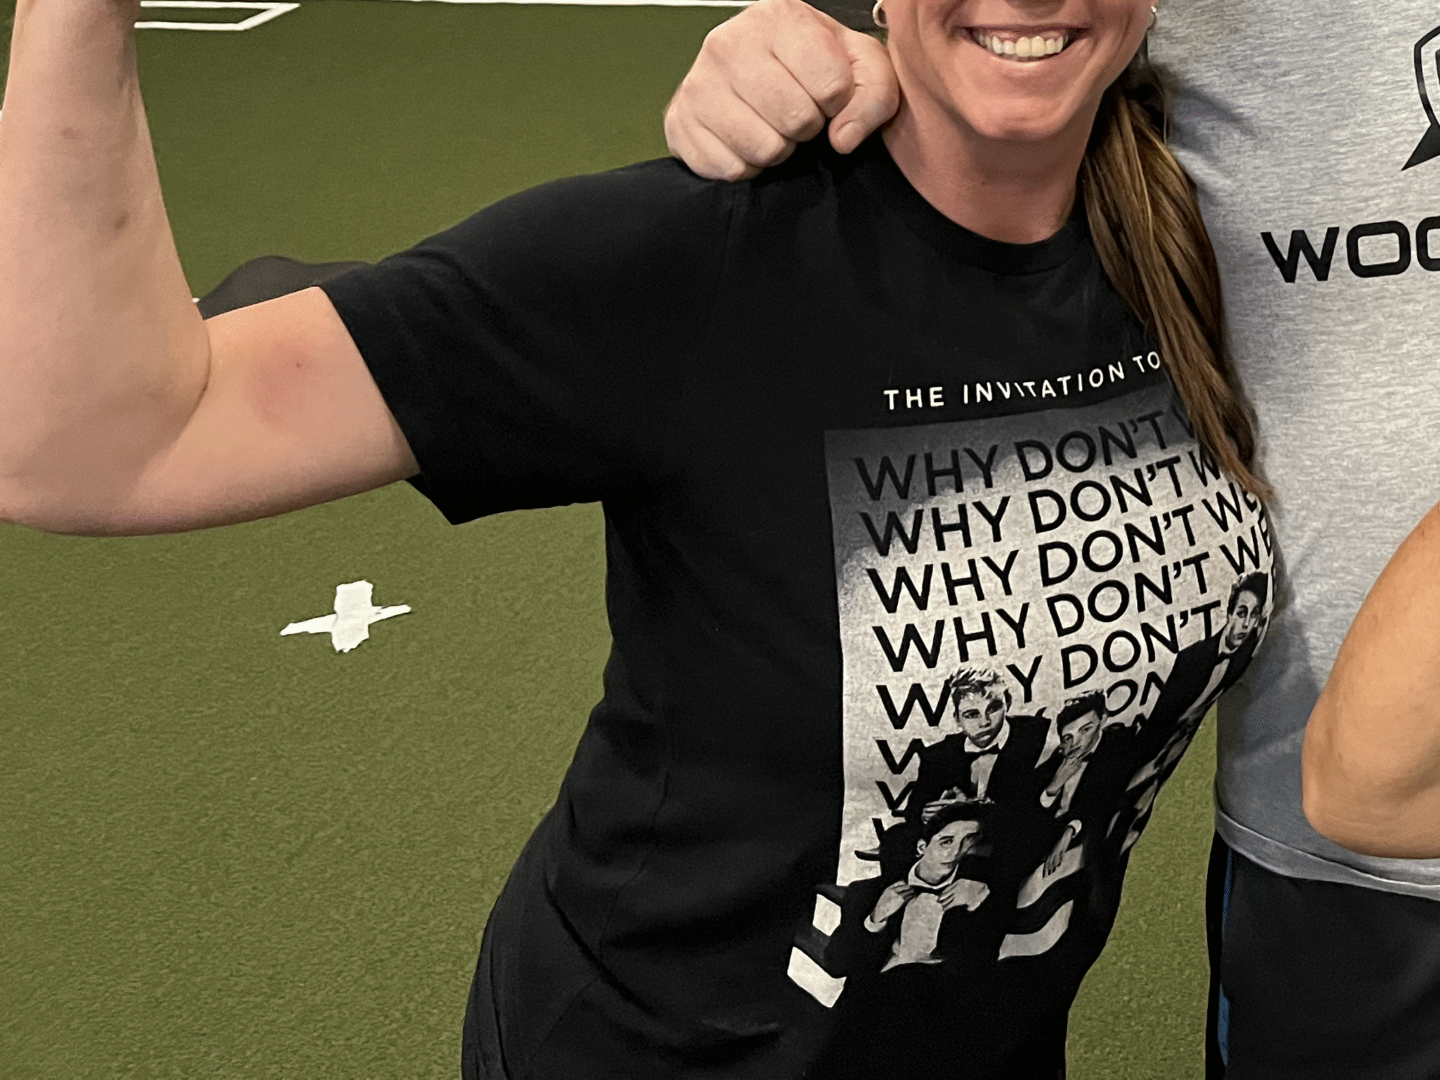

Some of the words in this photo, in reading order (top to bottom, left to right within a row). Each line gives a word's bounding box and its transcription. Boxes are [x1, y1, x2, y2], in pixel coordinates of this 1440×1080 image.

[883, 386, 944, 410] THE
[963, 361, 1125, 405] INVITATION
[1132, 351, 1160, 373] TO
[854, 444, 998, 501] WHY
[1015, 410, 1167, 481] DON'T
[859, 496, 1010, 557] WHY
[1028, 456, 1181, 533] DON'T
[866, 550, 1019, 614] WHY
[1038, 504, 1196, 587] DON'T
[872, 602, 1030, 672] WHY
[1046, 552, 1209, 638] DON'T
[876, 655, 1043, 730] WY
[1061, 600, 1221, 689] DON'T
